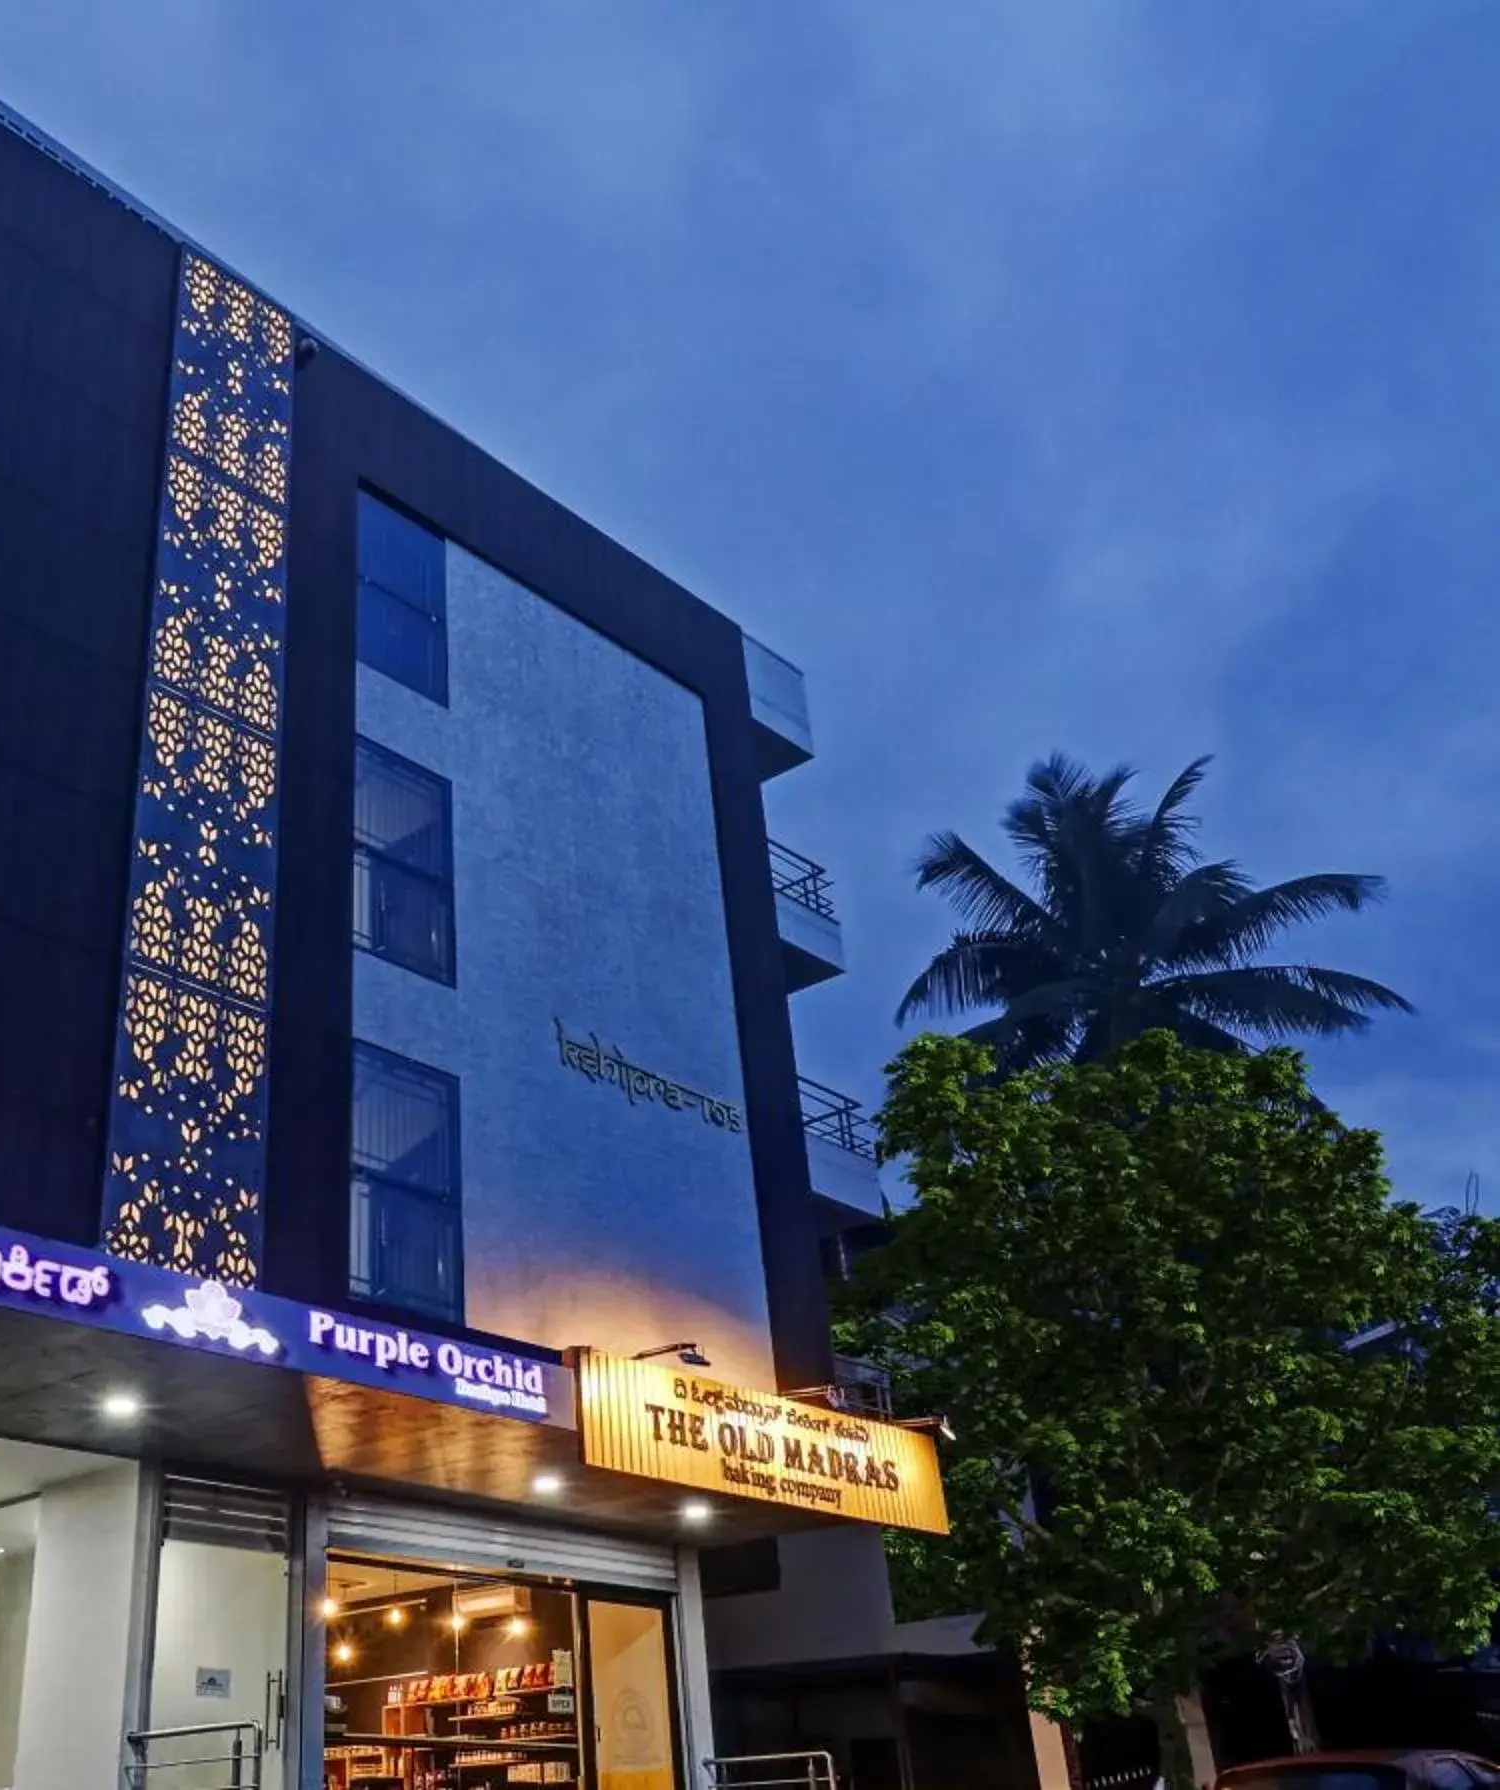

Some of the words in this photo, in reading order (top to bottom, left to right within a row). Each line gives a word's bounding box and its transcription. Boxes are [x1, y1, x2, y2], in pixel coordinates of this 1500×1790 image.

[308, 1309, 430, 1370] Purple
[437, 1342, 544, 1394] Orchid
[645, 1402, 709, 1453] THE
[718, 1422, 776, 1465] OLD
[781, 1435, 900, 1491] MADRAS
[721, 1457, 777, 1497] baking
[780, 1476, 842, 1510] company
